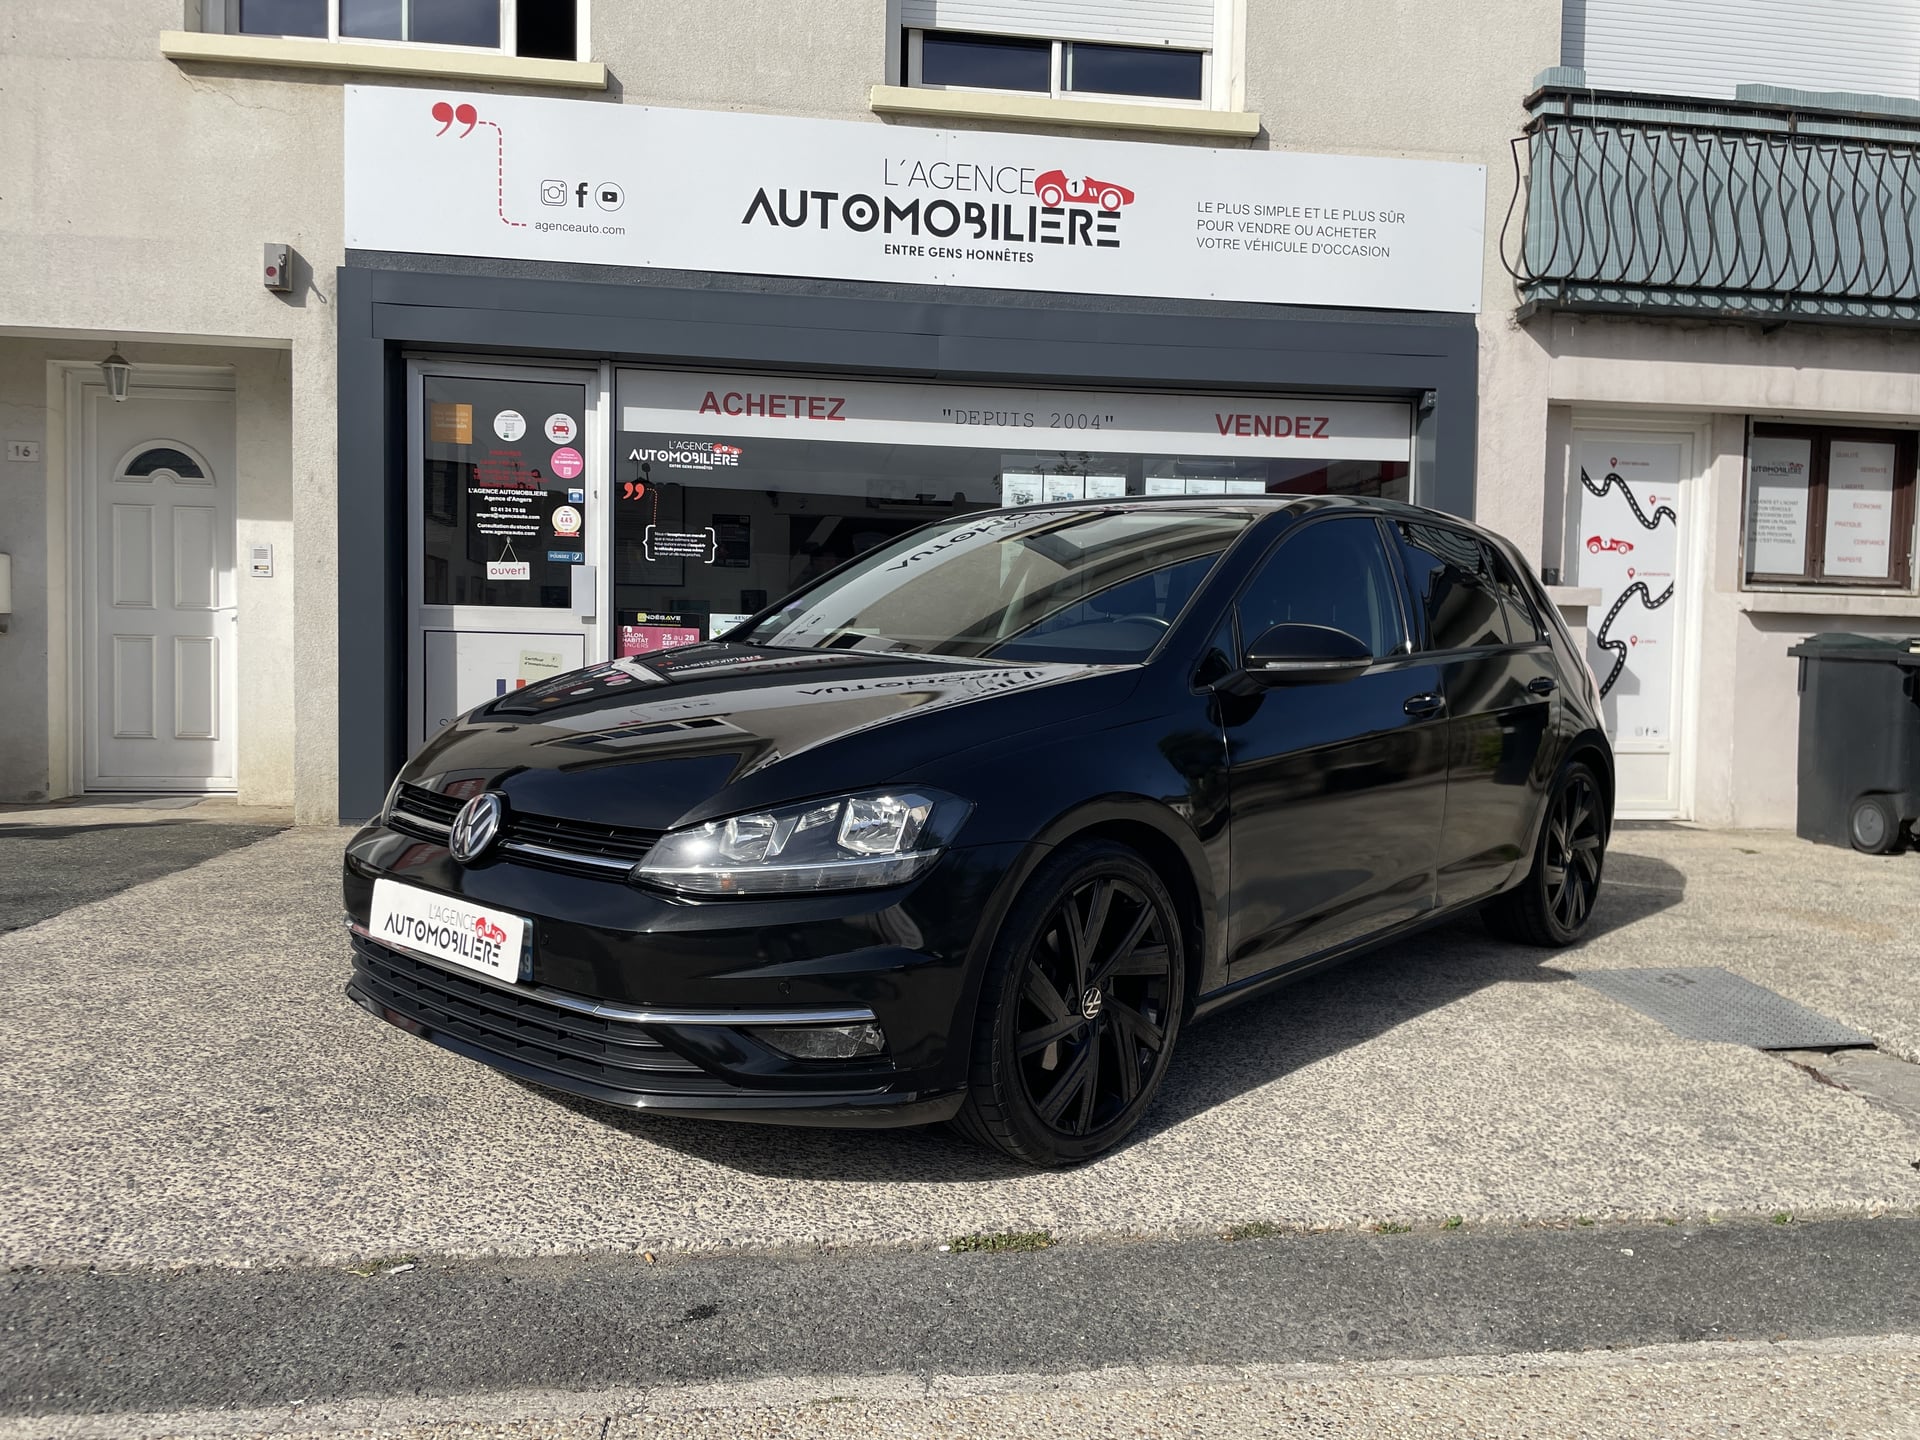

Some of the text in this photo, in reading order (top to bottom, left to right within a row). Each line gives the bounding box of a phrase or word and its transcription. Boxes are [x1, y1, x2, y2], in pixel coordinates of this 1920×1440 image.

[1197, 201, 1405, 224] LE PLUS SIMPLE ET LE PLUS SÛR
[534, 220, 626, 236] agenceauto.com
[1197, 219, 1377, 239] POUR VENDRE OU ACHETER
[884, 244, 1034, 263] ENTRE GENS HONNÊTES
[1196, 237, 1390, 258] VOTRE VÉHICULE D'OCCASION
[698, 391, 846, 422] ACHETEZ
[1215, 412, 1330, 440] VENDEZ
[15, 445, 31, 457] 16
[668, 440, 713, 452] L'AGENCE
[468, 487, 498, 495] L'AGENCE
[490, 565, 527, 576] ouvert
[428, 903, 477, 932] L'AGENCE
